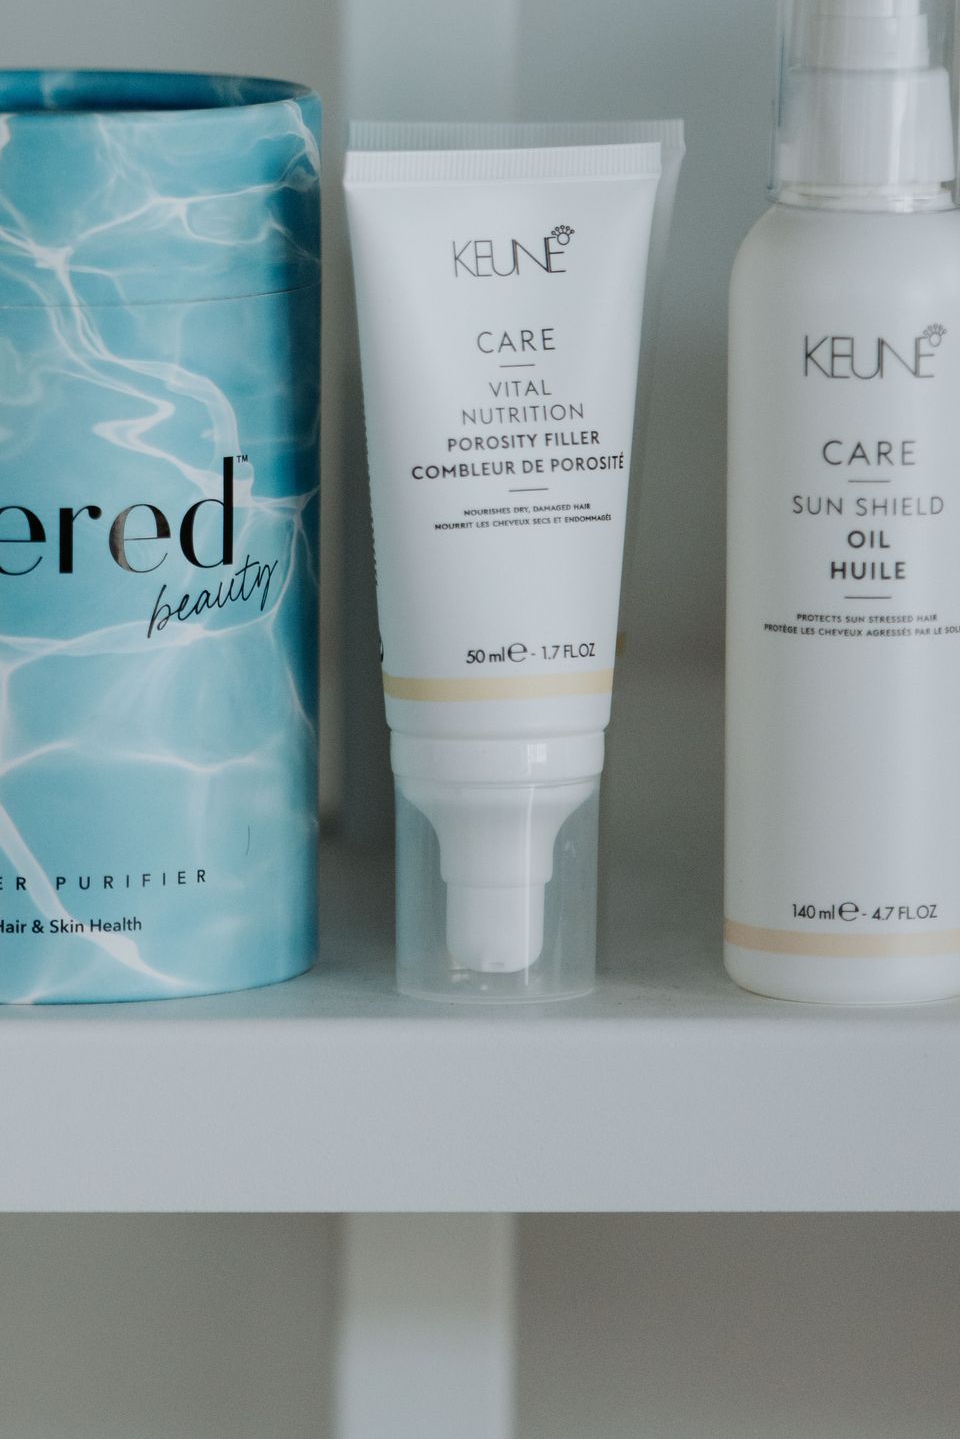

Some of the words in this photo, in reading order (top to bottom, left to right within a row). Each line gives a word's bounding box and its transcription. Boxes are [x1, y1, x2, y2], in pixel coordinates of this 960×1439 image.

[451, 235, 566, 278] KEUNE
[477, 328, 555, 353] CARE
[804, 335, 935, 379] KEUNE
[489, 380, 552, 397] VITAL
[462, 403, 583, 425] NUTRITION
[448, 434, 537, 452] POROSITY
[545, 431, 600, 446] FILLER
[822, 440, 916, 465] CARE
[411, 461, 515, 480] COMBLEUR
[522, 459, 544, 473] DE
[551, 454, 624, 471] POROSITÉ
[793, 495, 842, 515] SUN
[856, 497, 943, 517] SHIELD
[435, 522, 473, 530] NOURRIT
[476, 520, 490, 528] LES
[492, 518, 530, 527] CHEVEUX
[533, 517, 551, 525] SECS
[847, 530, 890, 548] OIL
[831, 561, 904, 580] HUILE
[147, 555, 278, 638] beauty
[797, 613, 841, 623] PROTECTS
[845, 615, 865, 623] SUN
[868, 615, 913, 623] STRESSED
[764, 623, 797, 634] PROTÈGE
[818, 628, 862, 637] CHEVEUX
[466, 650, 485, 664] 50
[542, 645, 560, 659] 1.7
[56, 870, 205, 891] PURIFIER
[793, 904, 815, 919] 140
[872, 907, 894, 920] 4.7
[32, 920, 44, 933] &
[50, 918, 84, 934] Skin
[90, 916, 142, 933] Health
